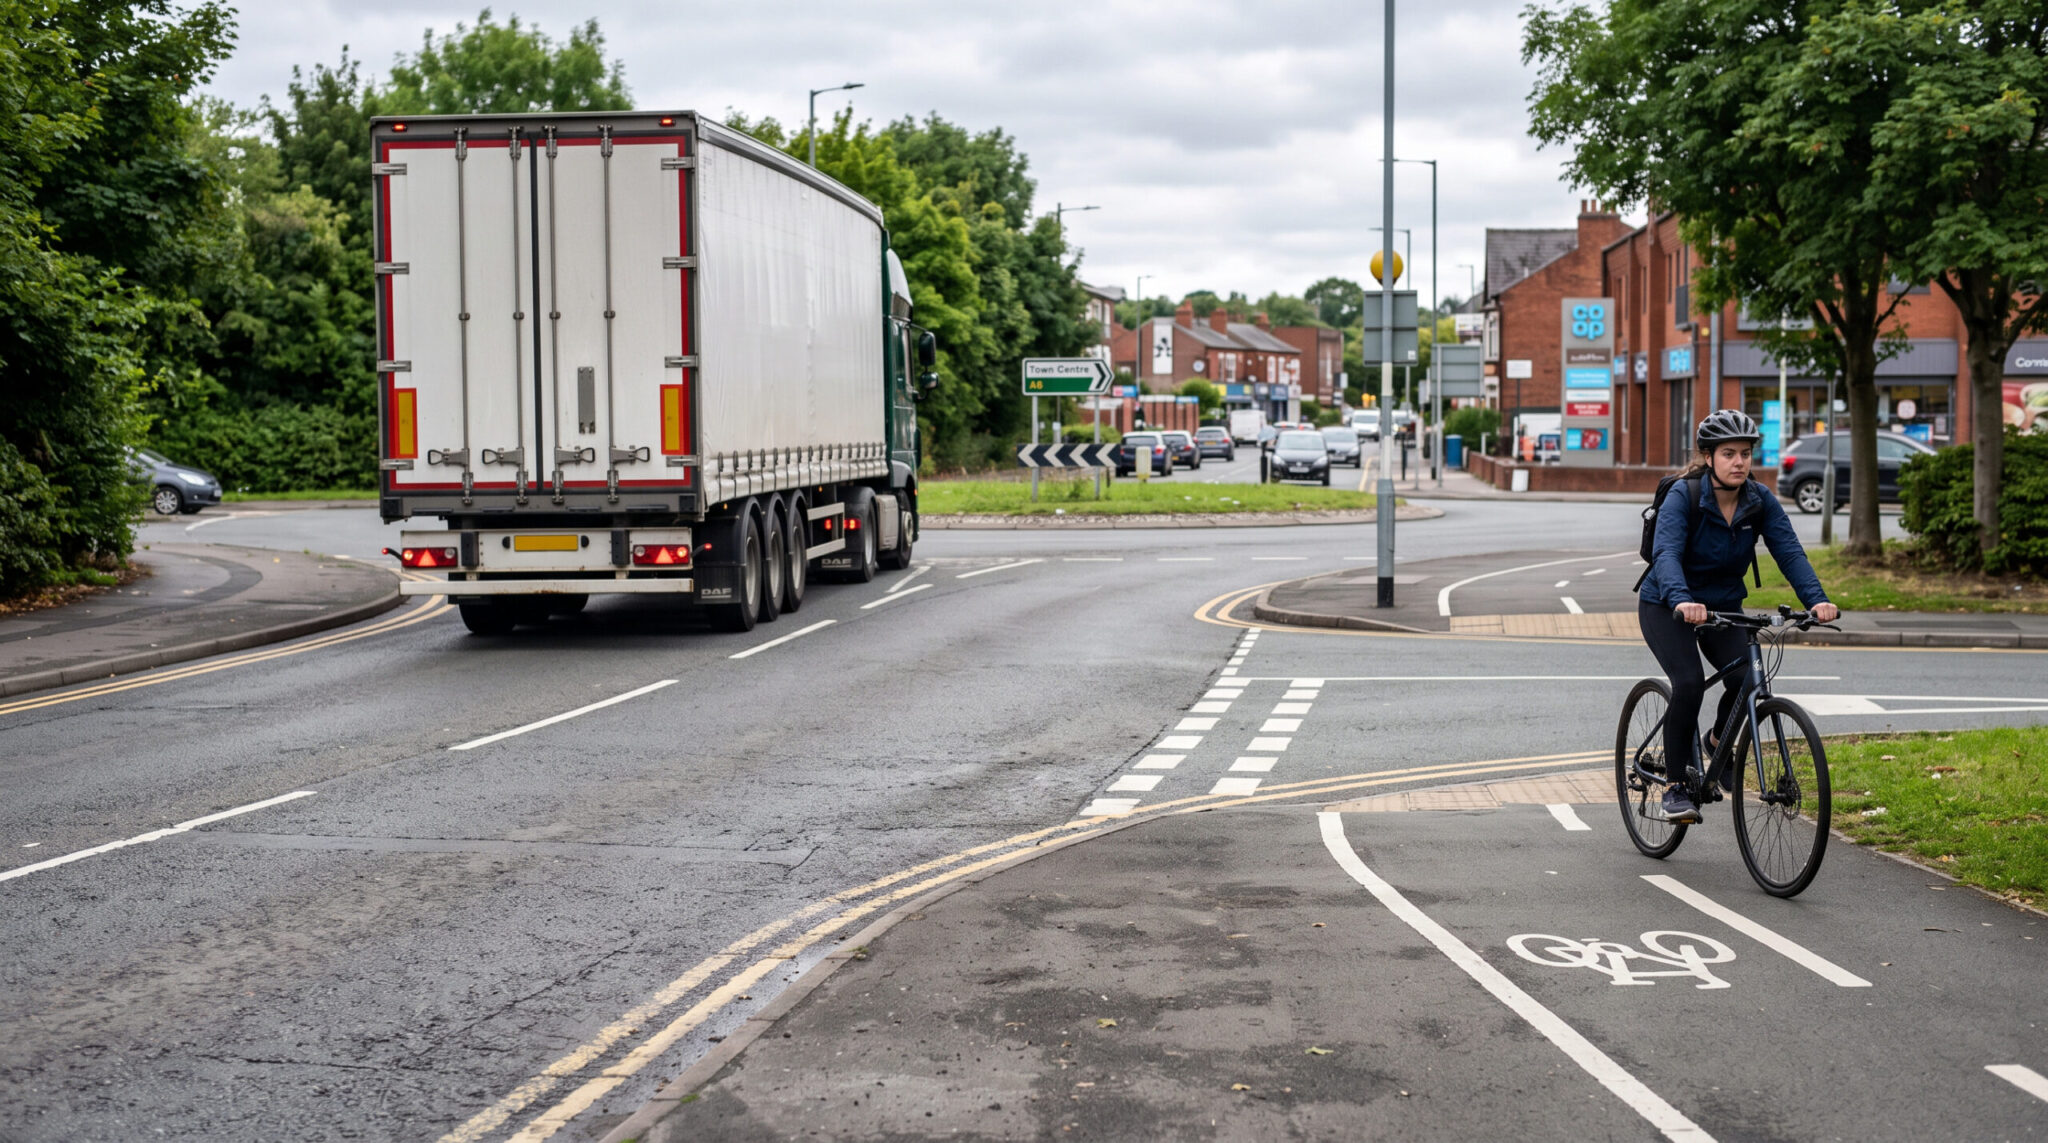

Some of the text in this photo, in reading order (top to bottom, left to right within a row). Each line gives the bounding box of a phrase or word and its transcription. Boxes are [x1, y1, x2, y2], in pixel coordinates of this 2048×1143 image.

[1029, 364, 1089, 374] Town Centre
[701, 587, 732, 595] DAF
